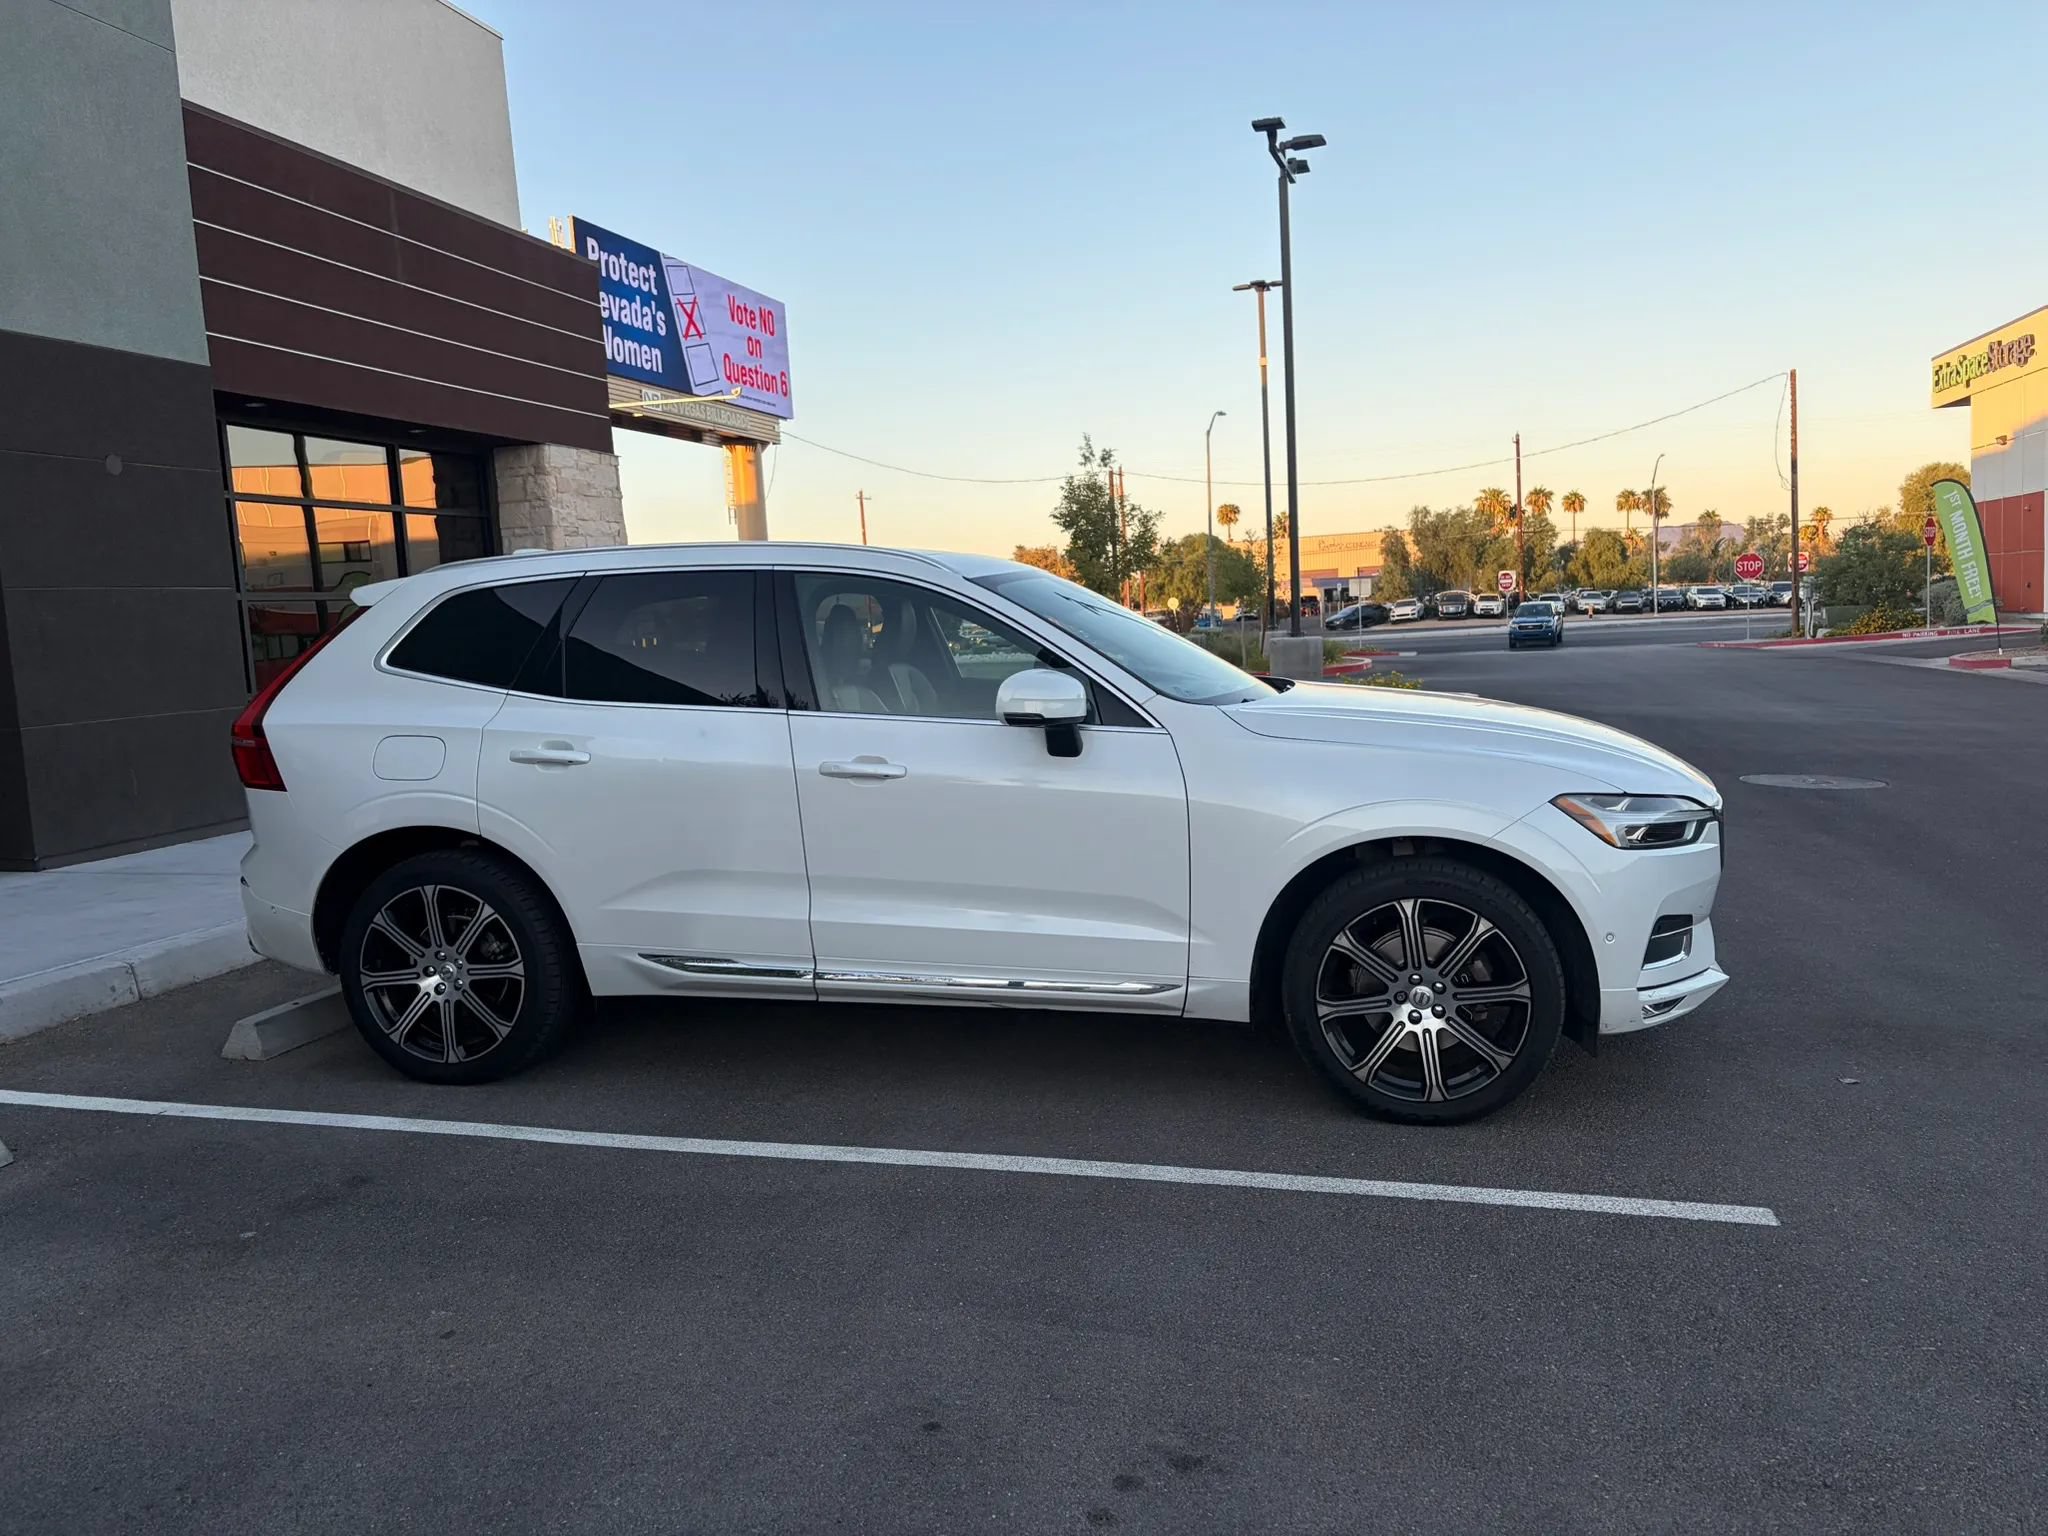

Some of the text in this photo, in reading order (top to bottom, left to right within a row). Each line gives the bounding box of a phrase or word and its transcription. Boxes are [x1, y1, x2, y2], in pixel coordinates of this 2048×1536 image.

[586, 236, 657, 295] Protect
[599, 291, 667, 336] evada's
[727, 294, 775, 337] Vote NO
[747, 336, 762, 359] on
[723, 353, 788, 397] Question 6
[1924, 526, 1936, 538] STOP
[1949, 509, 1974, 561] MONTH
[1736, 560, 1762, 572] STOP
